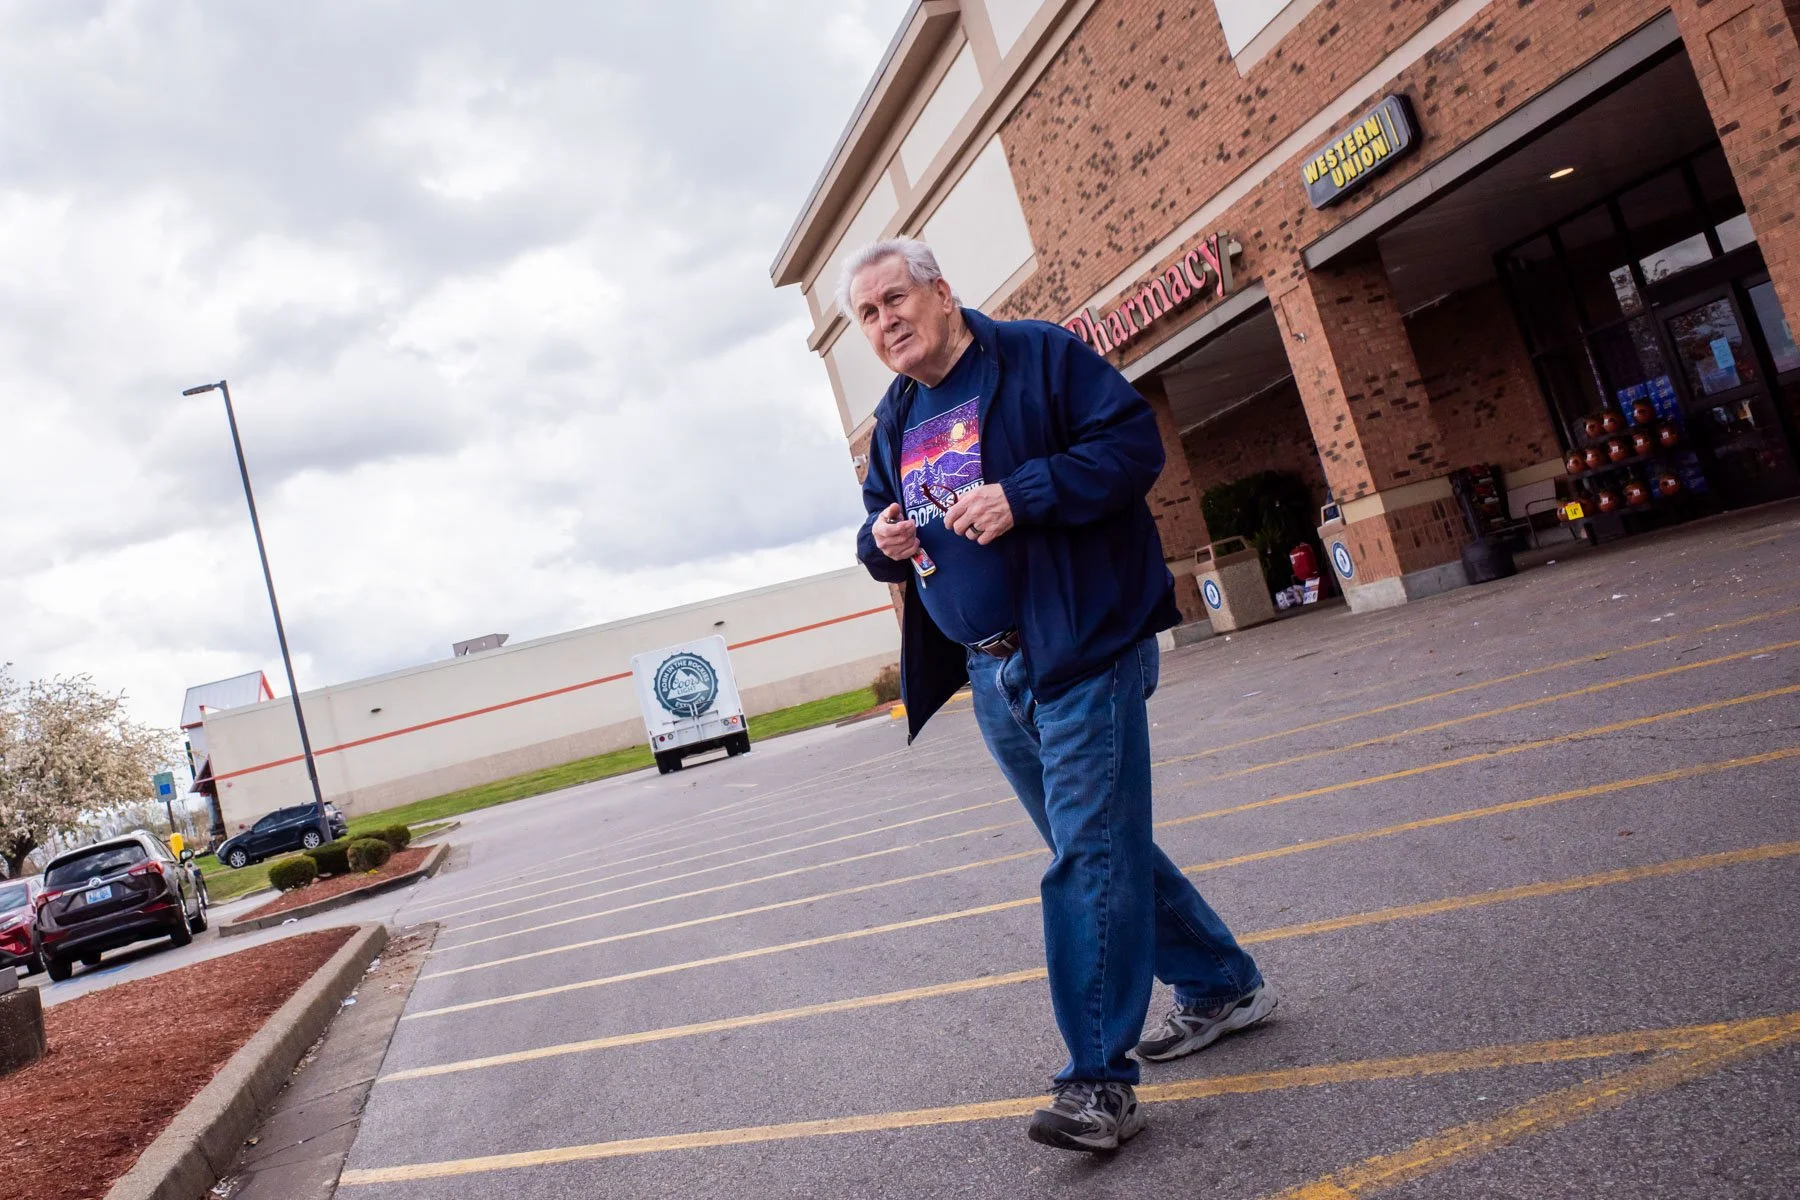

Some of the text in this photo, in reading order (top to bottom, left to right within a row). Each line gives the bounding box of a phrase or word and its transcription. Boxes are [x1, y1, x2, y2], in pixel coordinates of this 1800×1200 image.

[1303, 115, 1381, 184] WESTERN
[1331, 135, 1388, 187] UNION
[662, 660, 710, 692] BORN IN THE ROCKIES
[677, 686, 696, 695] LIGHT
